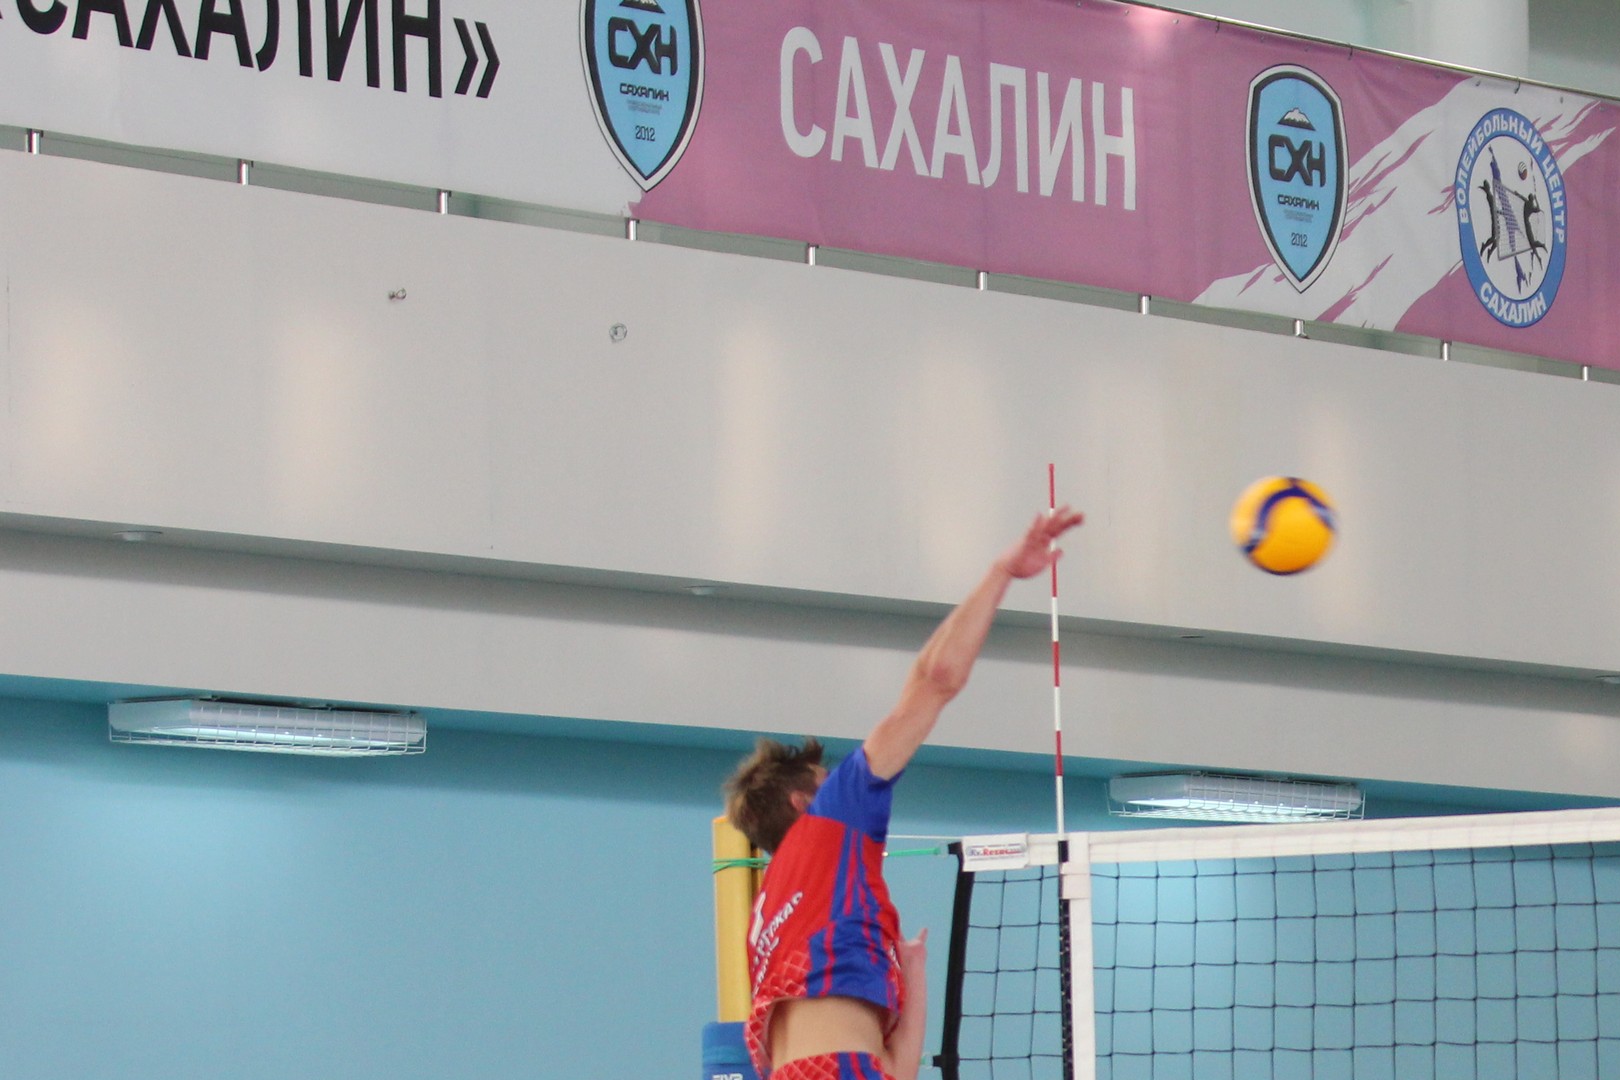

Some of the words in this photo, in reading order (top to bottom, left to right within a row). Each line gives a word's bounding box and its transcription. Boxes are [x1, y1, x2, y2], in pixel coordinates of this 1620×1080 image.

[635, 125, 656, 142] 2012
[780, 26, 1136, 211] САХАЛИН
[1456, 113, 1543, 225] ВОЛЕЙБОЛЬНЫЙ
[1542, 153, 1565, 244] ЦЕНТР
[1290, 231, 1308, 248] 2012
[1480, 281, 1547, 325] САХАЛИН
